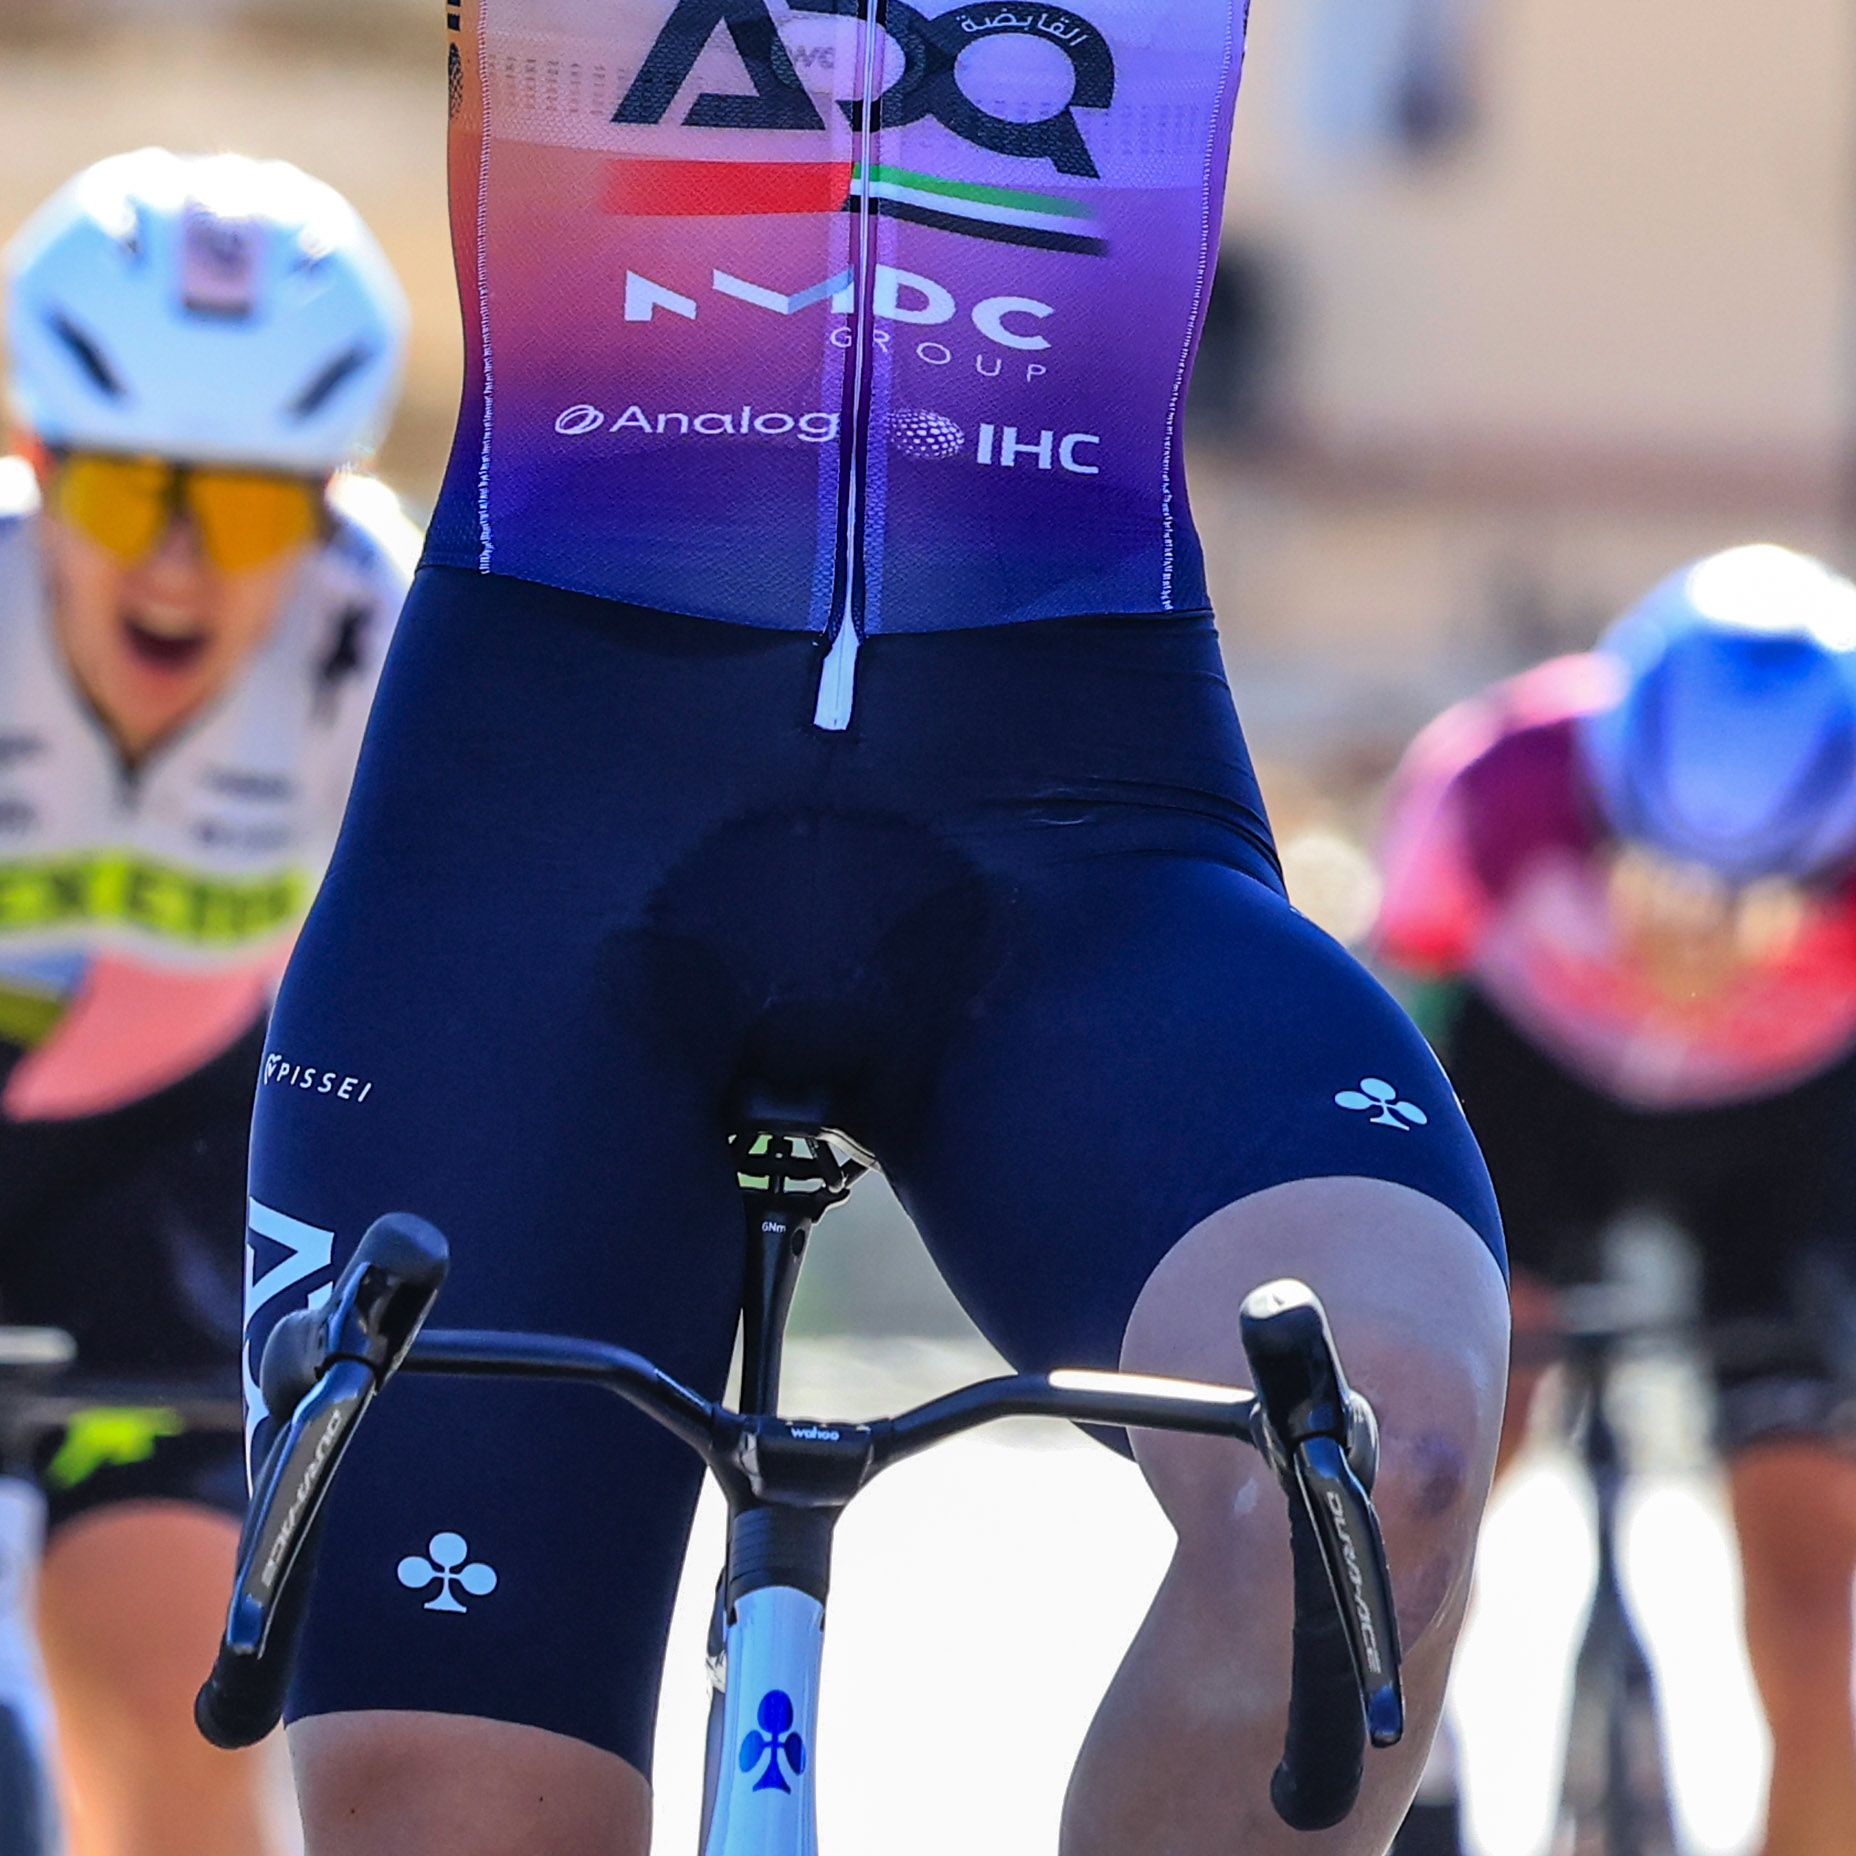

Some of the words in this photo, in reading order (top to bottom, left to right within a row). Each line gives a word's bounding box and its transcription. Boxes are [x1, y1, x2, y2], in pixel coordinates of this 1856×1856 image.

[955, 7, 1090, 47] القابضة
[829, 326, 1047, 383] GROUP
[609, 405, 842, 443] Analog
[975, 422, 1101, 475] IHC
[276, 1062, 372, 1103] PISSEI
[790, 1425, 841, 1441] wahoo
[1326, 1491, 1382, 1675] DURA-ACE
